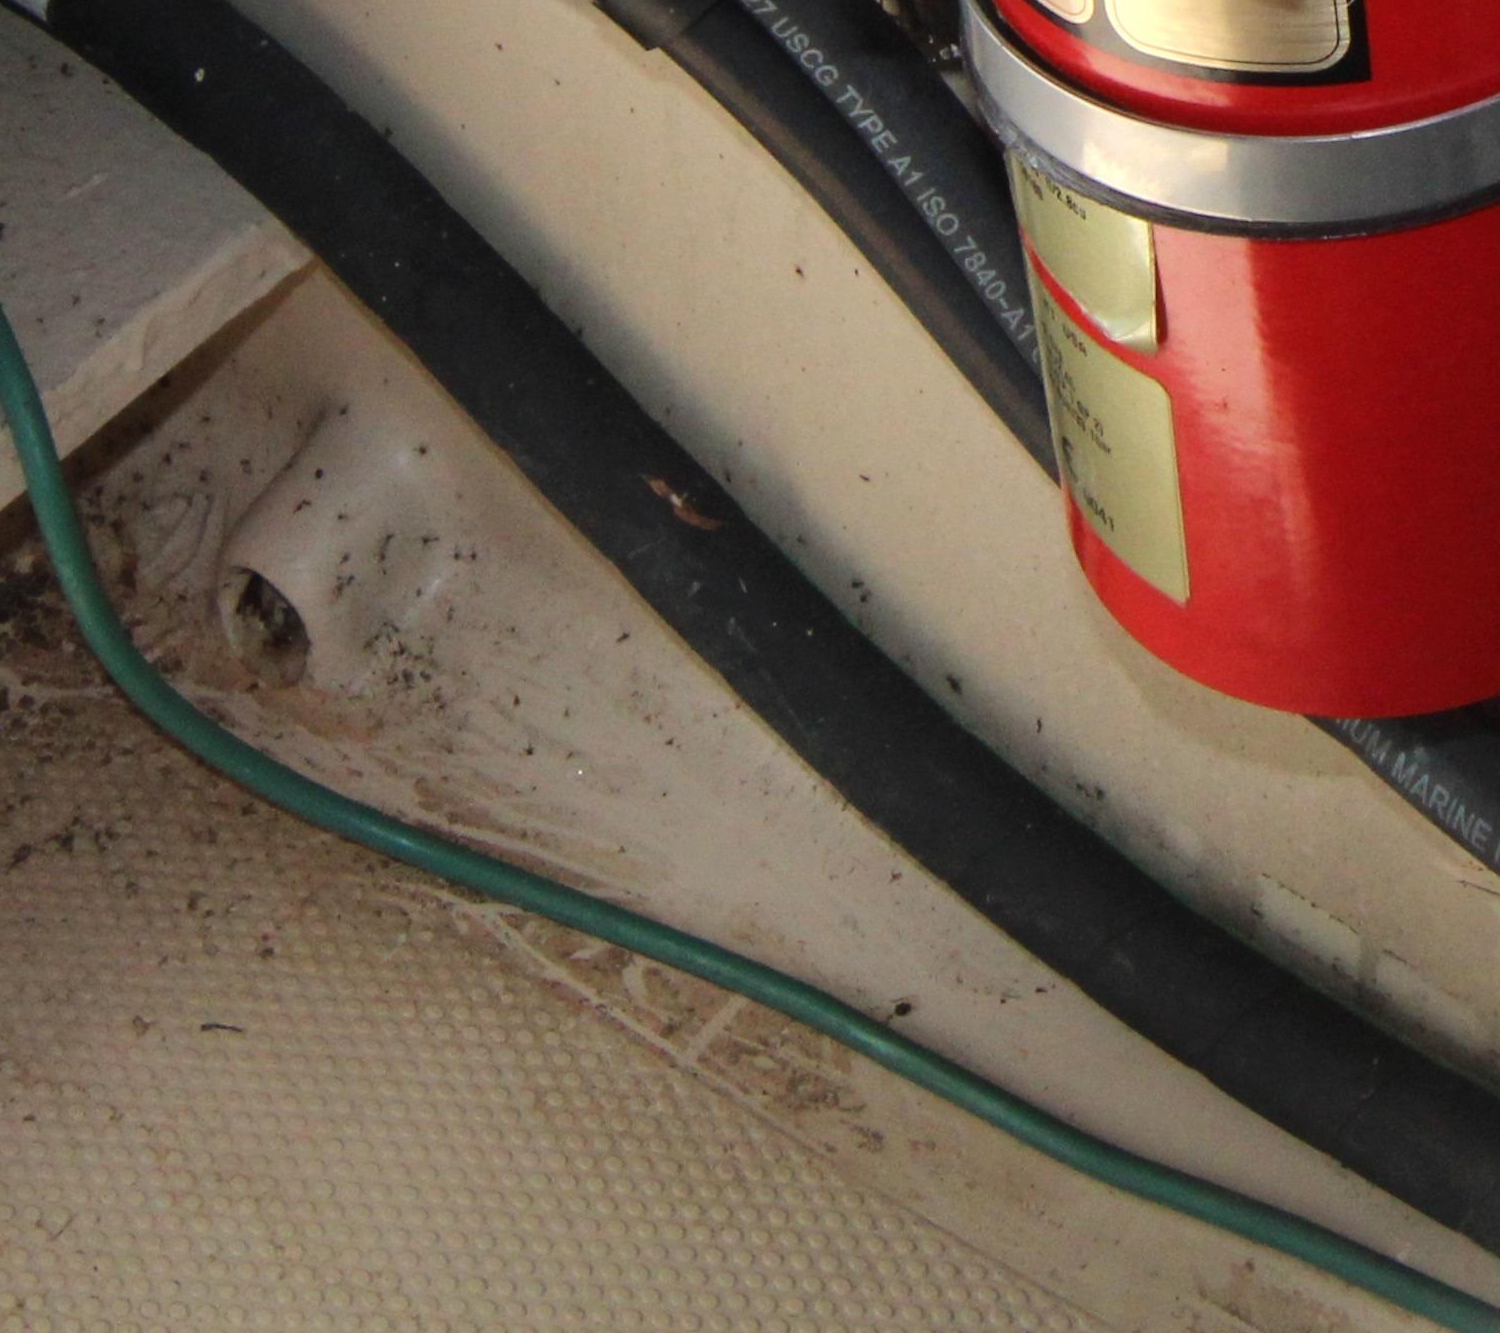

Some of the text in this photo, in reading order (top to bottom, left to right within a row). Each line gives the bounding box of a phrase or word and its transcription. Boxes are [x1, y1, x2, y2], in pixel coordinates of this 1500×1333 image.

[771, 15, 838, 86] USCG
[835, 83, 898, 153] TYPE
[890, 153, 923, 189] A1
[917, 185, 959, 234] ISO
[1391, 751, 1494, 854] MARINE
